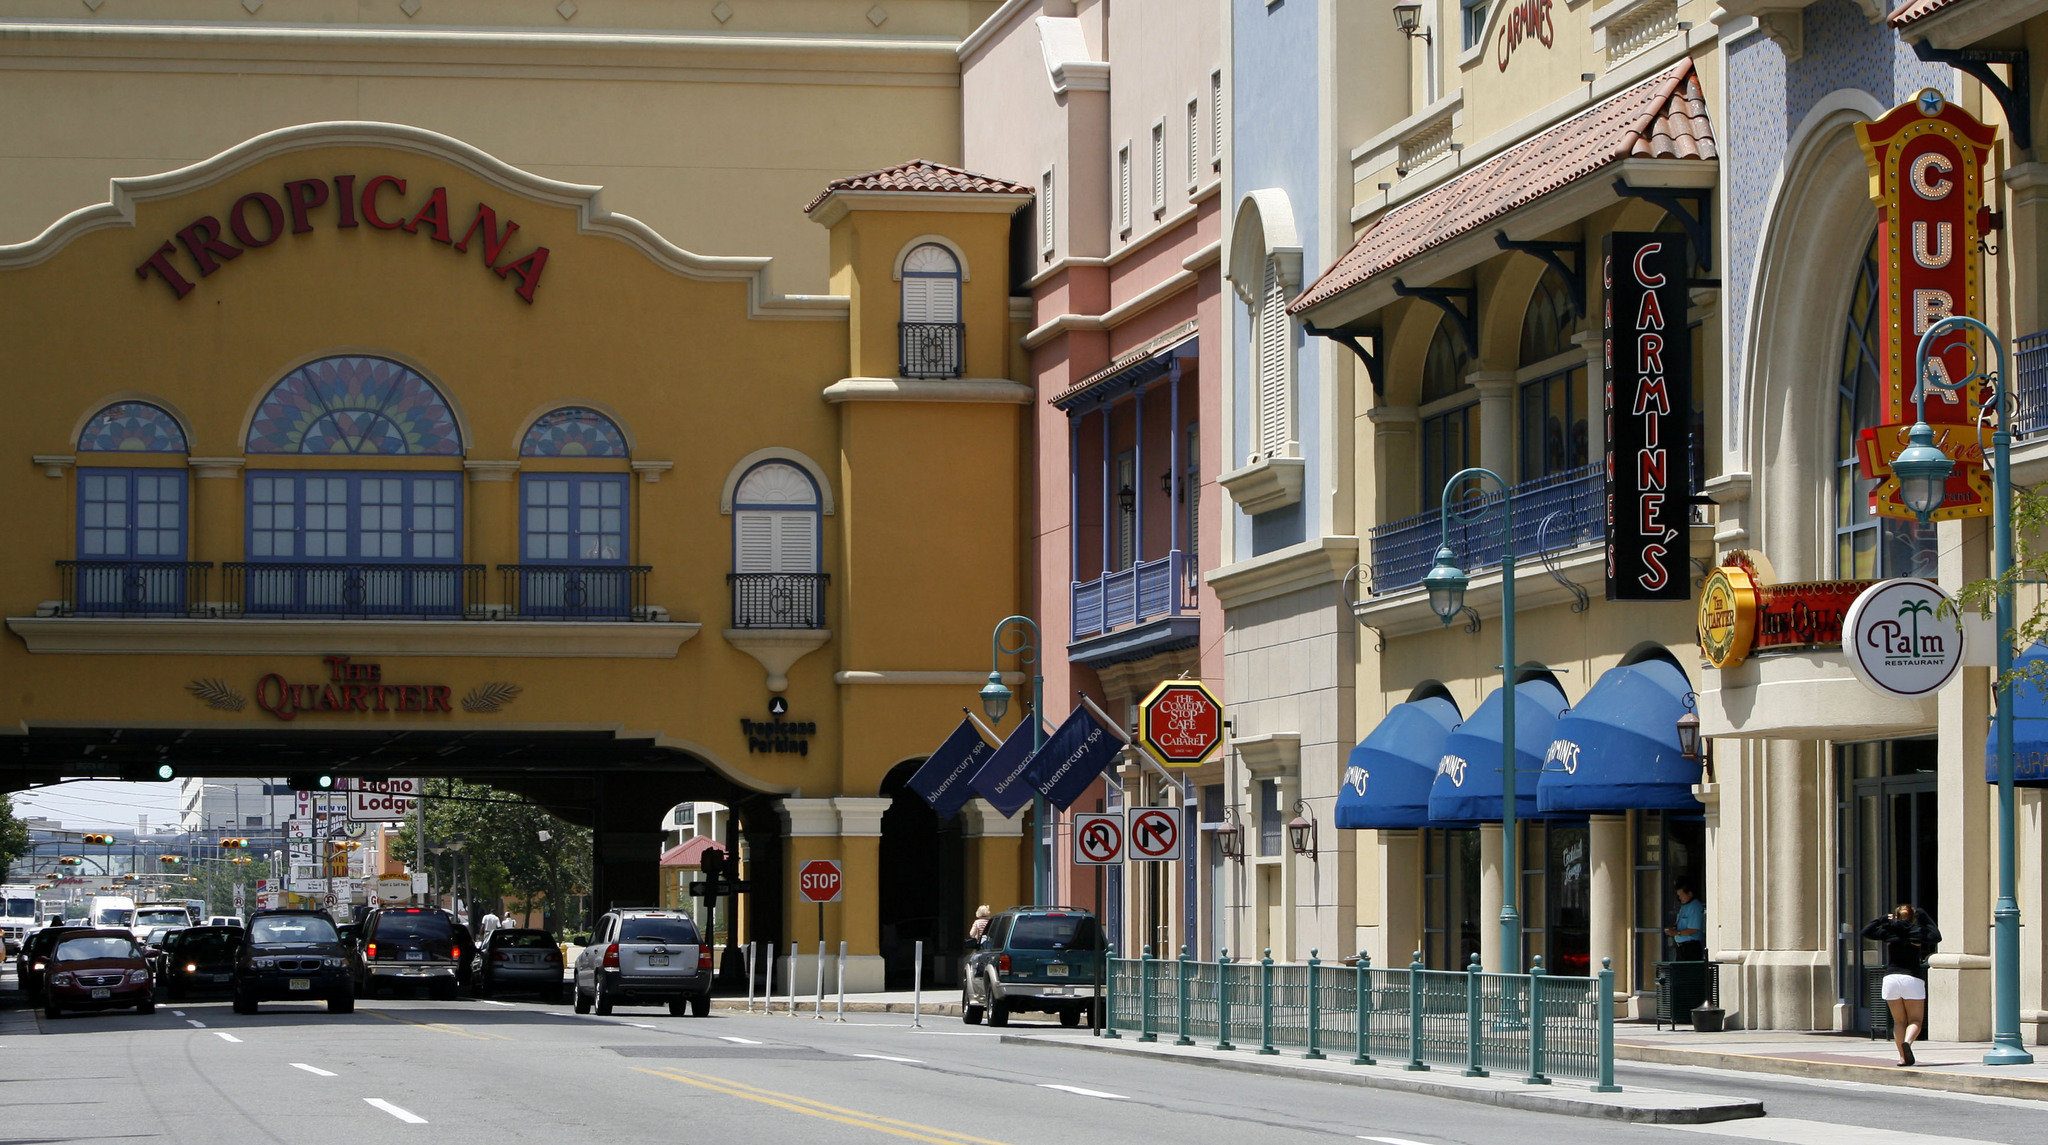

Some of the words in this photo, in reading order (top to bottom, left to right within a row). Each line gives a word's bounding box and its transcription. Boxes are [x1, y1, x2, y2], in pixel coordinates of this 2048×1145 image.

[136, 174, 550, 305] TROPICANA
[1909, 152, 1959, 405] CUBA
[1632, 243, 1678, 591] CARMINE'S
[1703, 608, 1735, 635] QUARTER
[323, 656, 381, 681] THE
[256, 673, 453, 721] QUARTER
[1174, 694, 1193, 704] THE
[1160, 700, 1207, 714] COMEDY
[1171, 709, 1198, 721] STOP
[740, 718, 816, 736] Tropicana
[1168, 720, 1196, 730] CAFE
[1180, 729, 1189, 738] &
[749, 736, 808, 757] Parking
[1160, 733, 1208, 746] CABARET
[1038, 742, 1090, 795] bluemercury
[1087, 728, 1102, 744] spa
[926, 755, 975, 803] bluemercury
[972, 741, 986, 755] spa
[268, 885, 279, 893] 25
[802, 873, 839, 889] STOP
